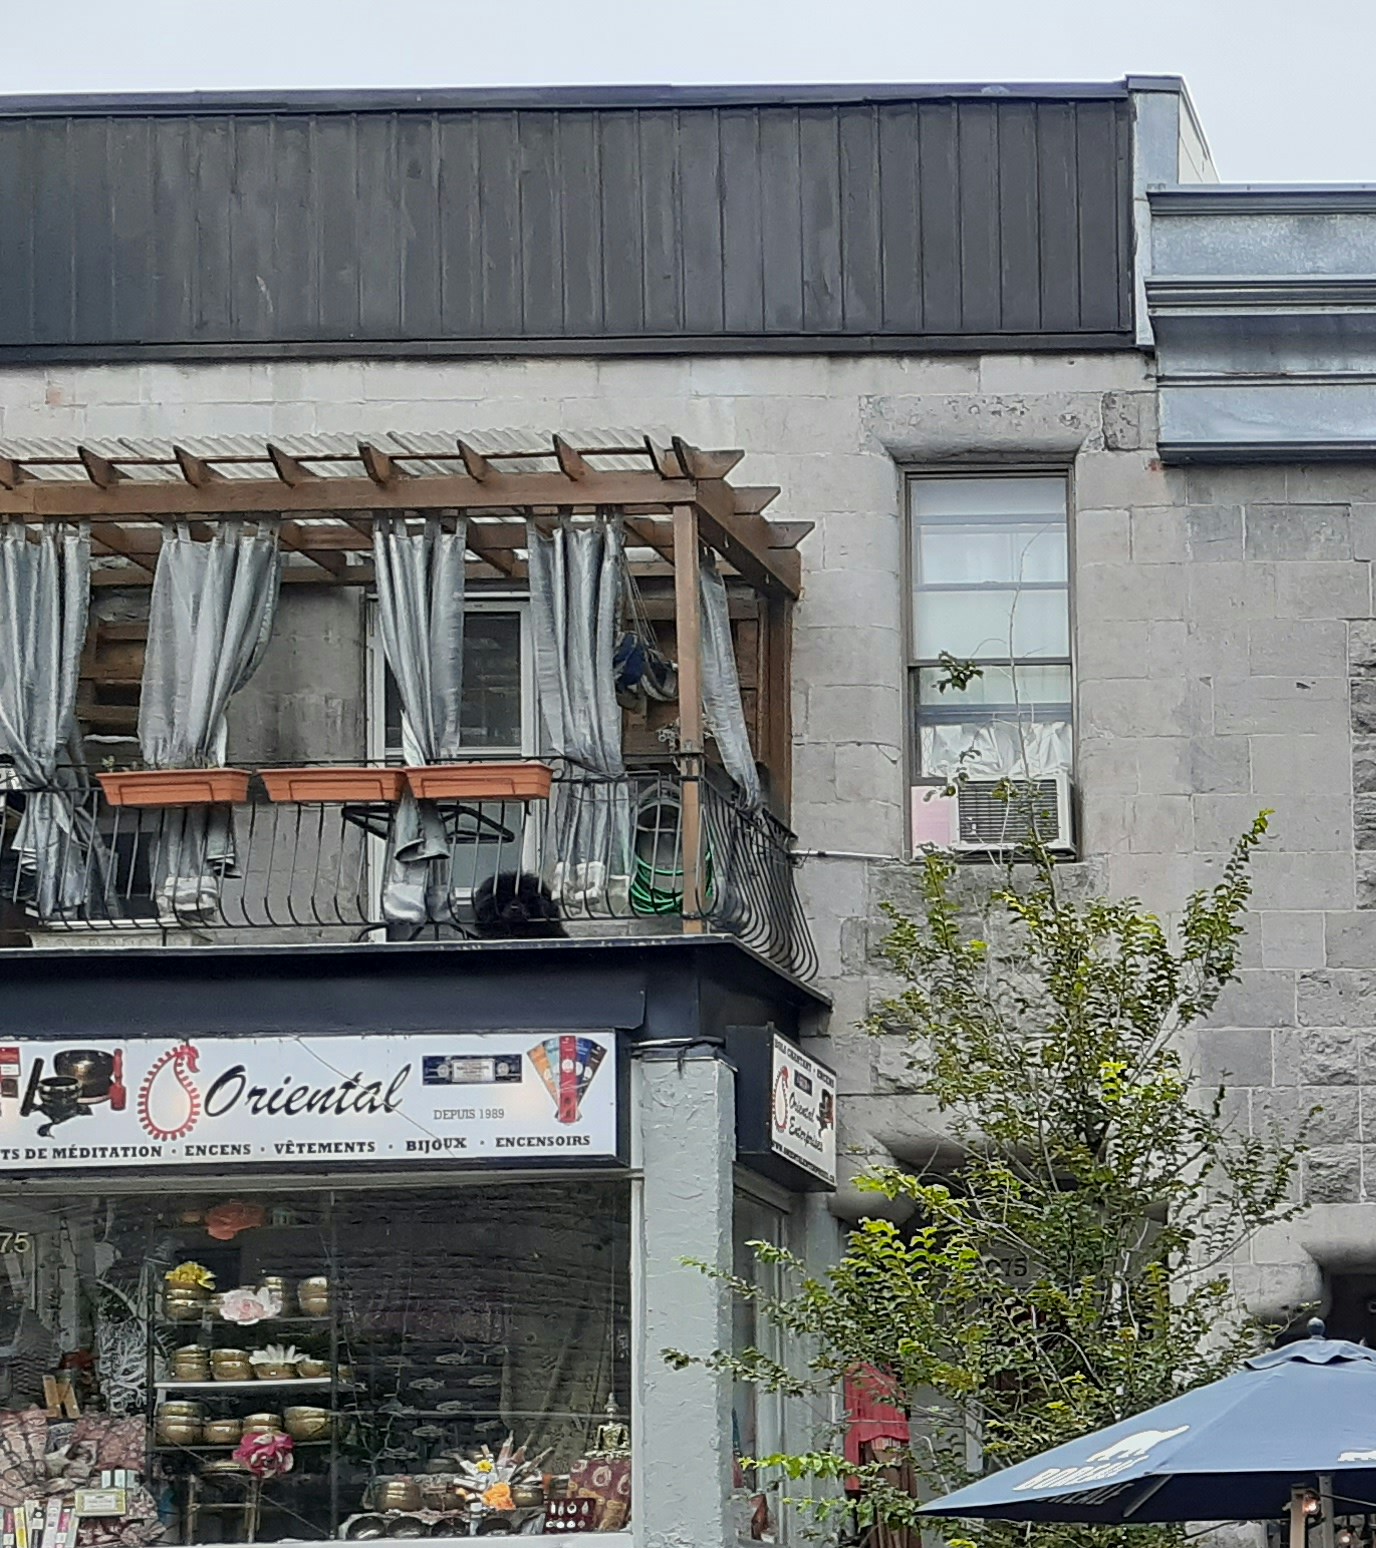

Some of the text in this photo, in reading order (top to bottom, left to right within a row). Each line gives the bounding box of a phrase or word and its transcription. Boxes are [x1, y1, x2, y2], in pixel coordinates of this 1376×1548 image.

[205, 1064, 412, 1118] Oriental
[433, 1107, 505, 1121] DEPUIS 1989
[24, 1147, 48, 1160] DE
[53, 1140, 163, 1159] MÉDITATION
[184, 1143, 252, 1157] ENCENS
[274, 1139, 376, 1155] VÊTEMENTS
[405, 1136, 468, 1154] BIJOUX
[495, 1134, 591, 1148] ENCENSOIRS
